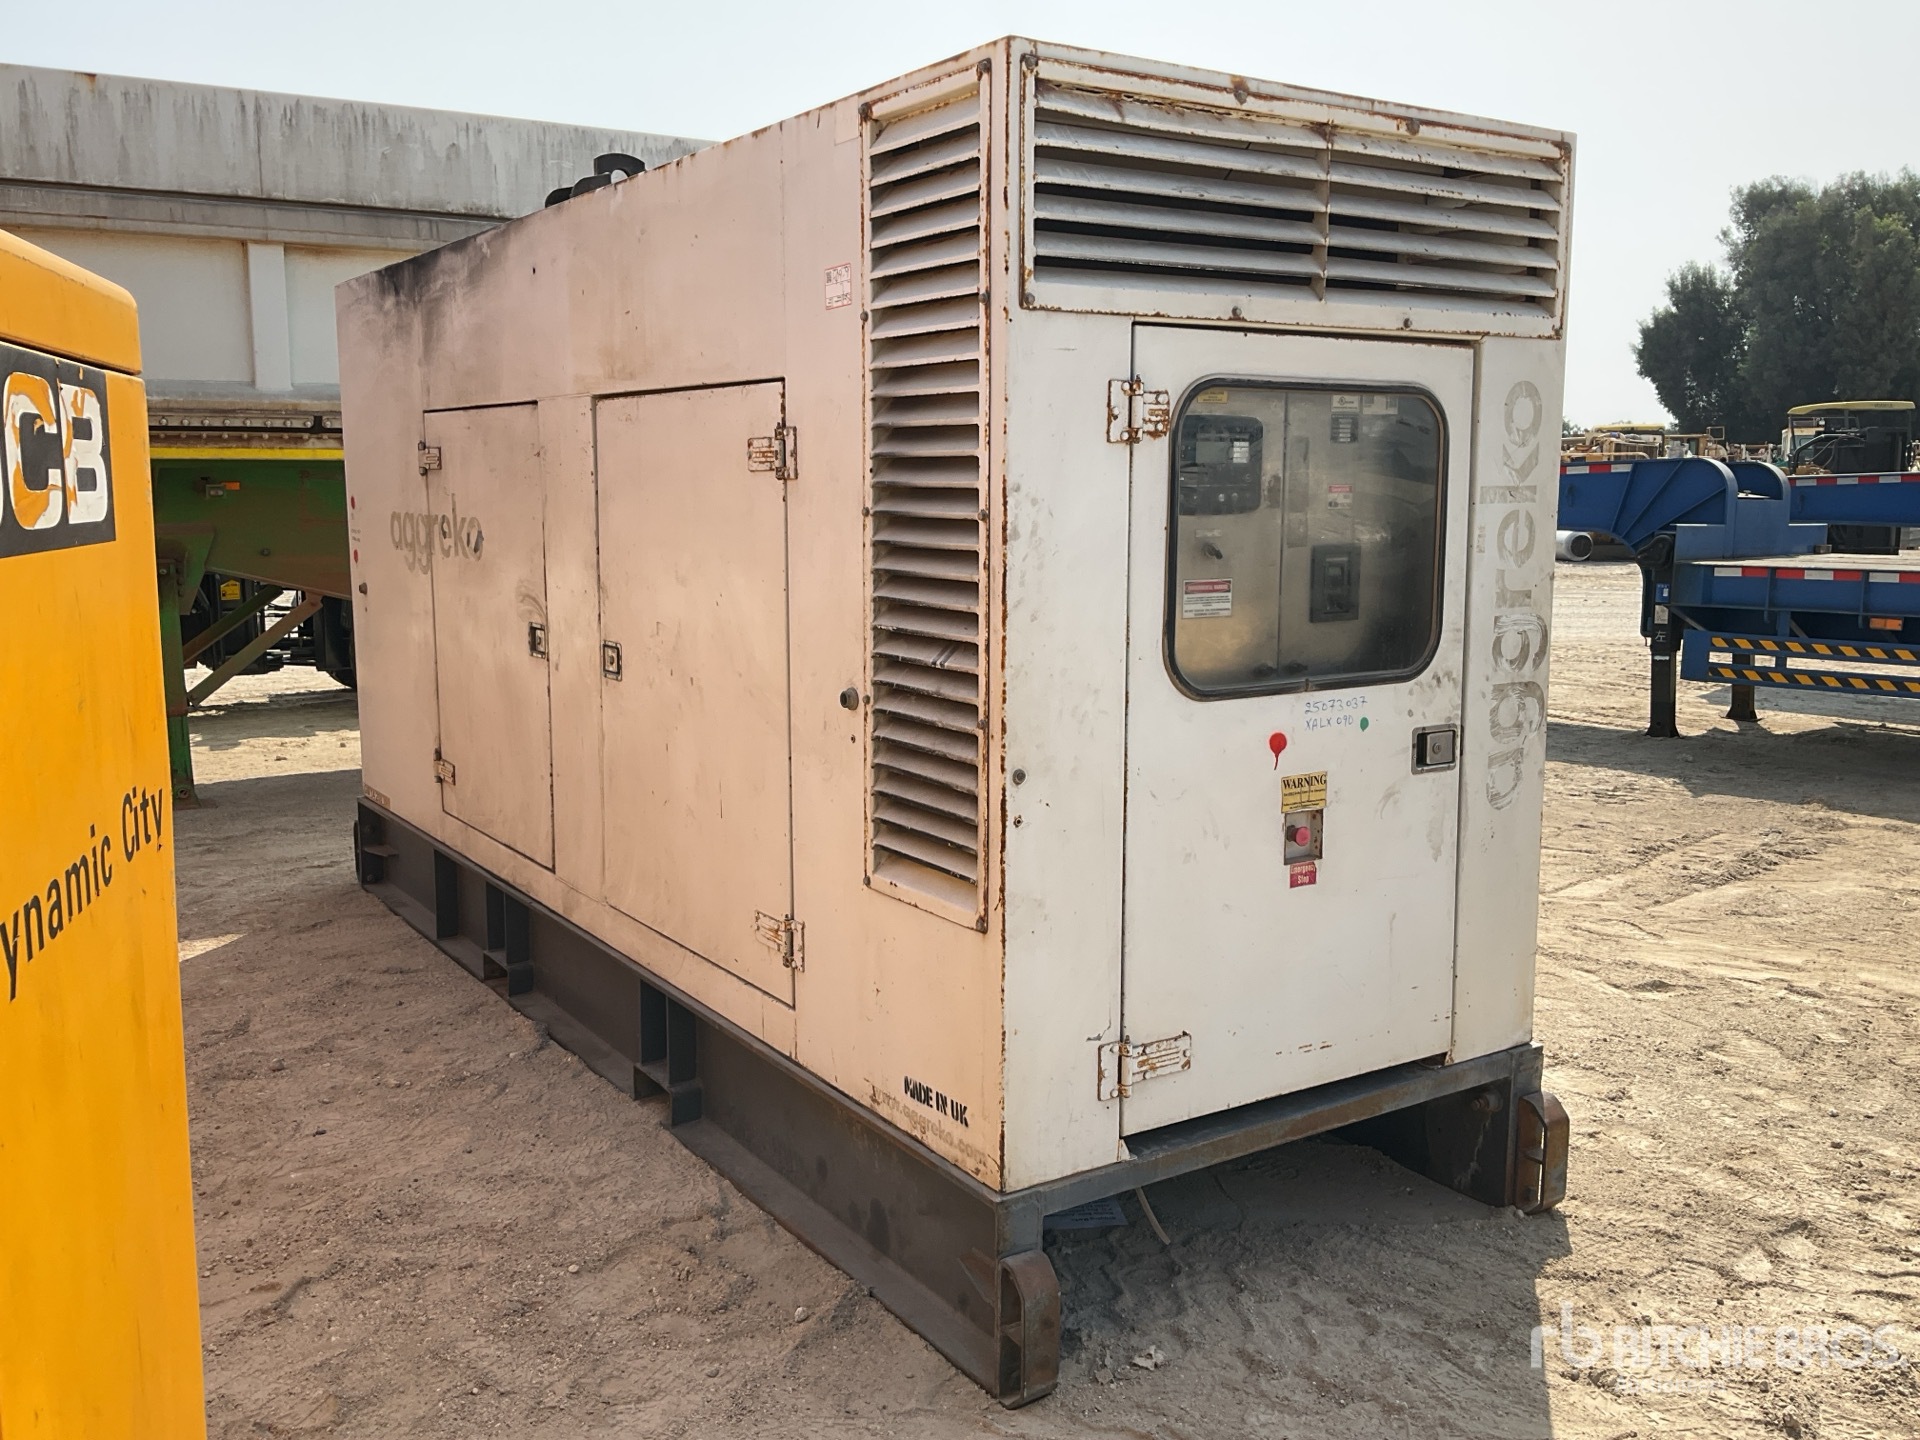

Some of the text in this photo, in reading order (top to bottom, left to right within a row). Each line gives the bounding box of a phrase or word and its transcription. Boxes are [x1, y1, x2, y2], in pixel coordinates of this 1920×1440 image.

[0, 371, 108, 531] CB
[390, 493, 485, 575] aggreko
[1479, 379, 1548, 811] aggreko
[1655, 630, 1667, 643] 左
[1282, 774, 1327, 790] WARNING
[121, 786, 163, 862] City
[1297, 875, 1310, 884] Stop
[903, 1075, 969, 1128] MADE IN UK
